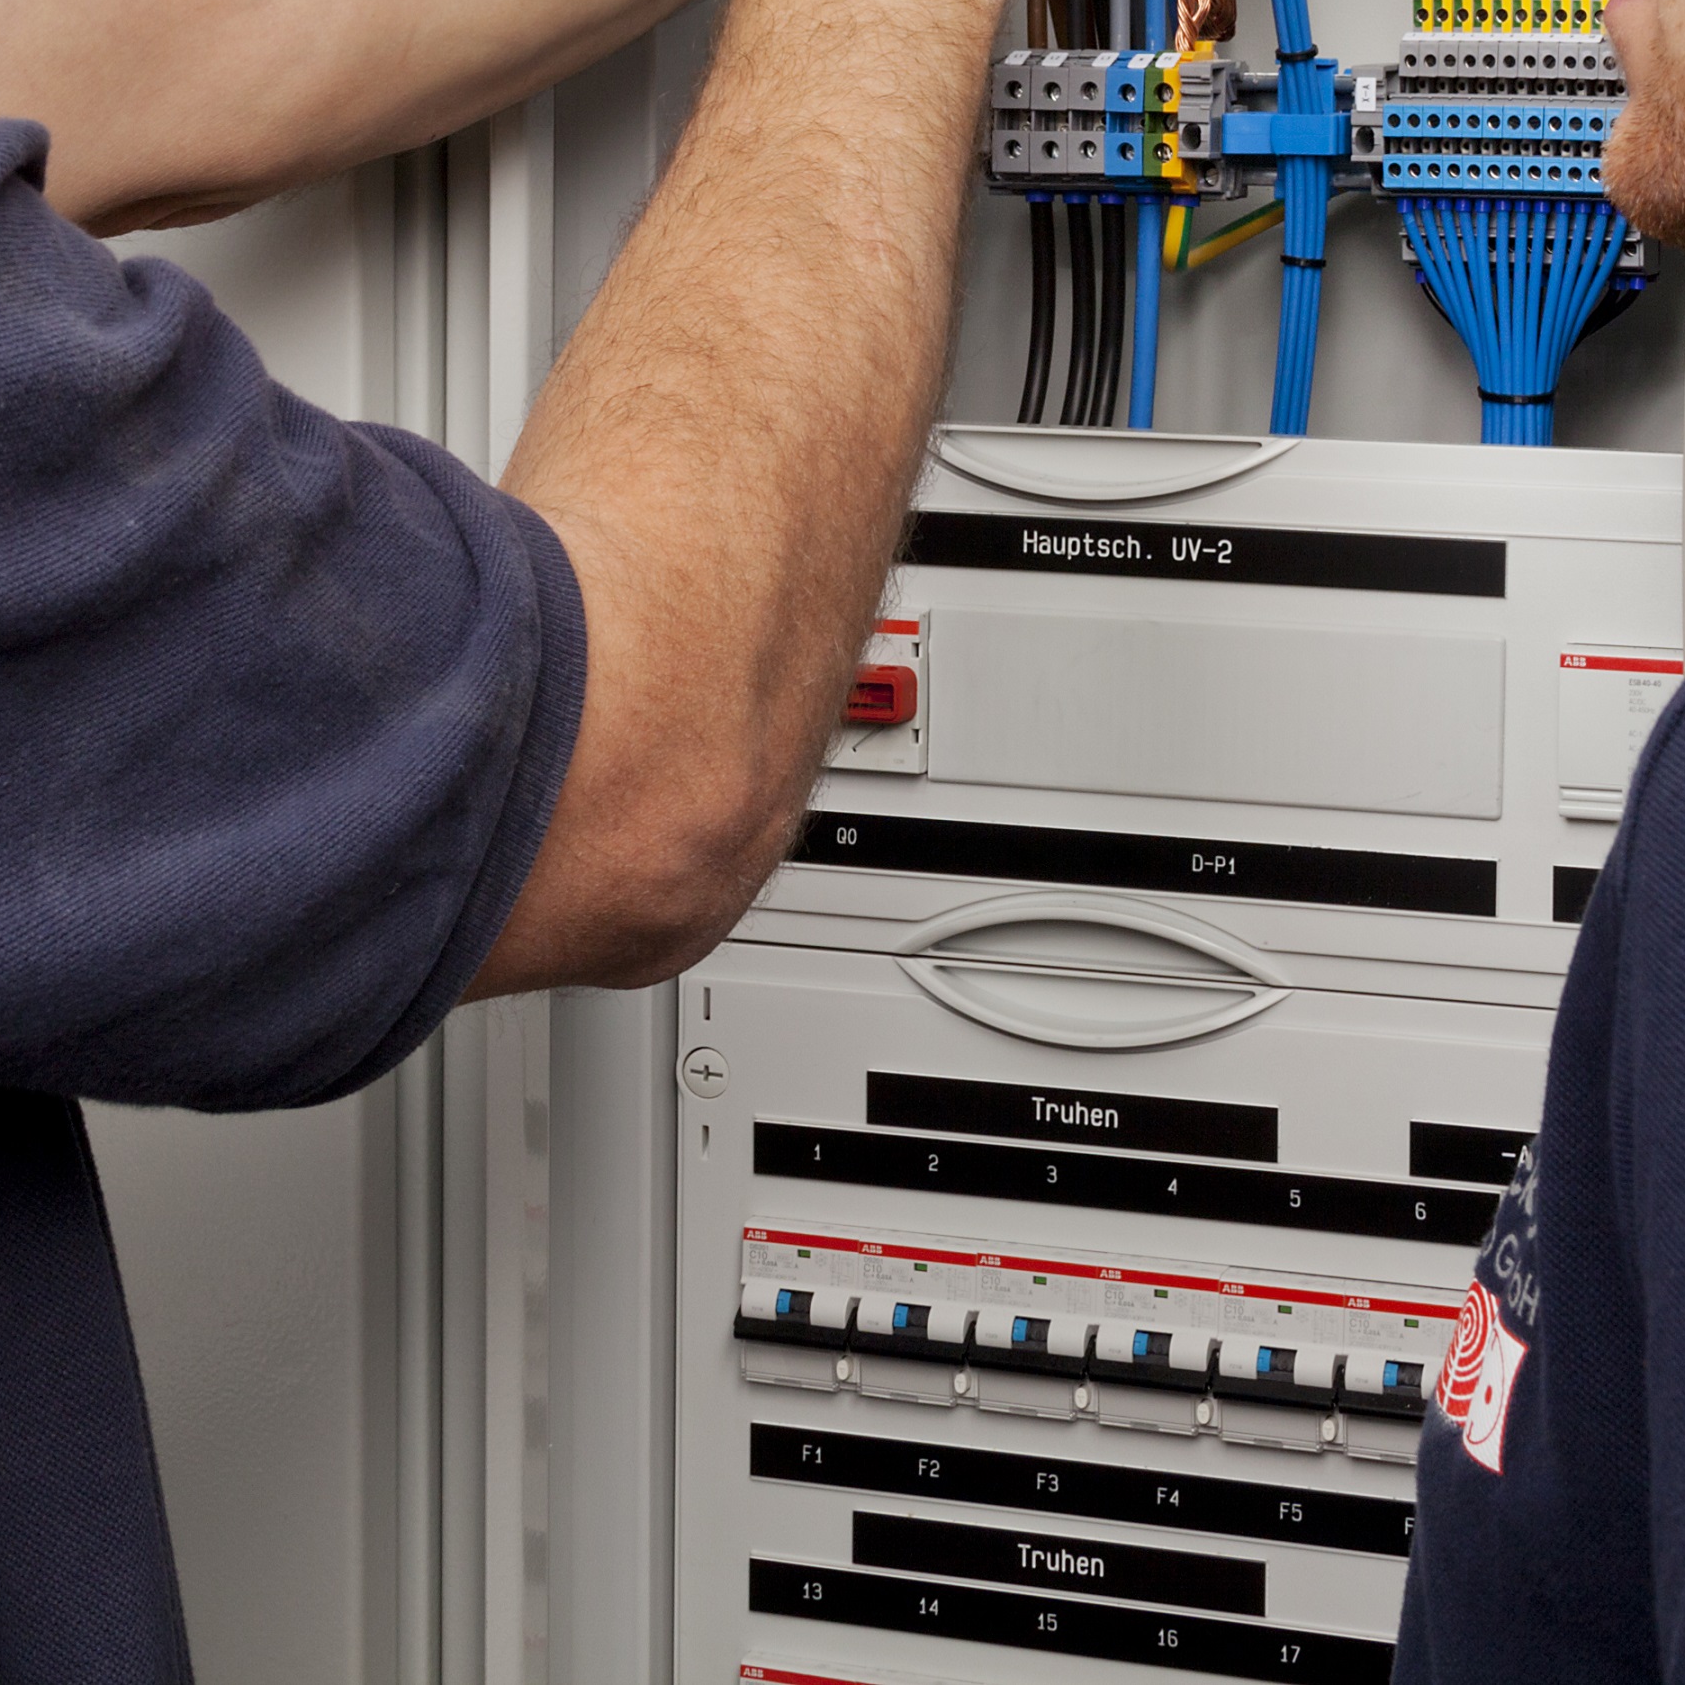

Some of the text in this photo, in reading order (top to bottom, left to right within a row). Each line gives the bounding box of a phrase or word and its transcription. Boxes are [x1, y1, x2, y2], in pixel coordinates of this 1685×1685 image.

[1022, 527, 1234, 565] Hauptsch. UV-2
[1563, 655, 1587, 667] ABB
[1190, 852, 1238, 878] D-P1
[1031, 1097, 1119, 1128] Truhen
[810, 1142, 824, 1165] 1
[926, 1153, 940, 1175] 2
[1045, 1164, 1059, 1186] 3
[1165, 1176, 1180, 1198] 4
[1288, 1189, 1303, 1211] 5
[1413, 1201, 1428, 1223] 6
[746, 1229, 768, 1240] ABB
[861, 1243, 883, 1254] ABB
[979, 1255, 1001, 1266] ABB
[1099, 1268, 1123, 1280] ABB
[1221, 1283, 1245, 1295] ABB
[1347, 1297, 1371, 1309] ABB
[801, 1444, 824, 1466] F1
[917, 1458, 941, 1479] F2
[1035, 1471, 1060, 1494] F3
[1155, 1486, 1180, 1508] F4
[1278, 1501, 1304, 1524] F5
[1016, 1545, 1105, 1580] Truhen
[802, 1581, 824, 1602] 13
[917, 1595, 940, 1618] 14
[1036, 1611, 1059, 1633] 15
[1156, 1627, 1179, 1650] 16
[1279, 1644, 1302, 1666] 17
[742, 1667, 765, 1678] ABB
